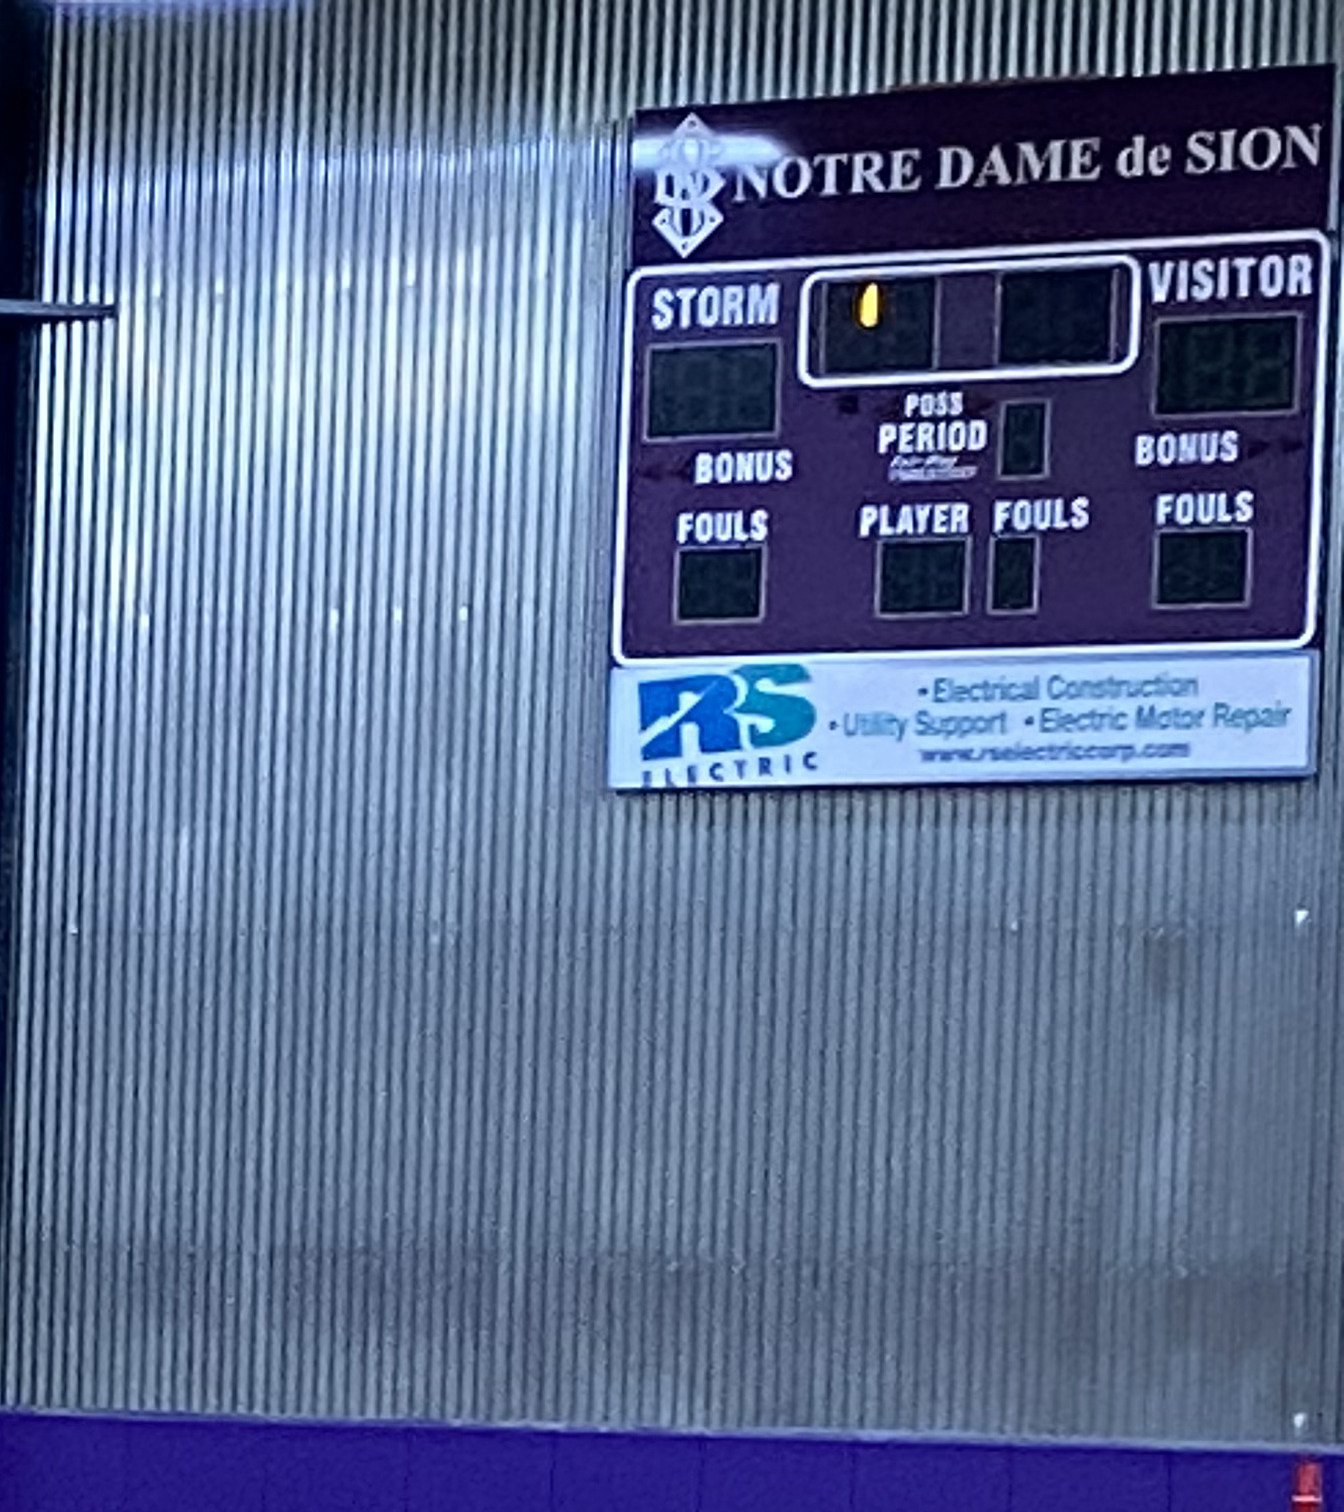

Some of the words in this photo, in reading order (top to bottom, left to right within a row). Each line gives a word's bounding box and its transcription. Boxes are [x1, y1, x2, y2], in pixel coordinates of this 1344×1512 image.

[734, 148, 921, 202] NOTRE
[936, 137, 1101, 189] DAME
[1117, 135, 1170, 178] de
[1185, 123, 1322, 174] SION
[1149, 255, 1313, 302] VISITOR
[651, 282, 779, 328] STORM
[905, 392, 962, 417] POSS
[879, 420, 987, 453] PERIOD
[1135, 430, 1238, 466] BONUS
[695, 449, 792, 484] BONUS
[859, 503, 969, 538] PLAYER
[994, 497, 1089, 533] FOULS
[1156, 491, 1254, 525] FOULS
[677, 510, 768, 543] FOULS
[932, 675, 1040, 703] Electrical
[1047, 671, 1199, 701] Construction
[638, 664, 817, 761] RS
[843, 710, 907, 742] Utility
[915, 710, 1007, 738] Support
[1039, 705, 1128, 732] Electric
[1135, 703, 1206, 730] Motor
[1213, 701, 1290, 732] Repair
[642, 752, 818, 787] ELECTRIC
